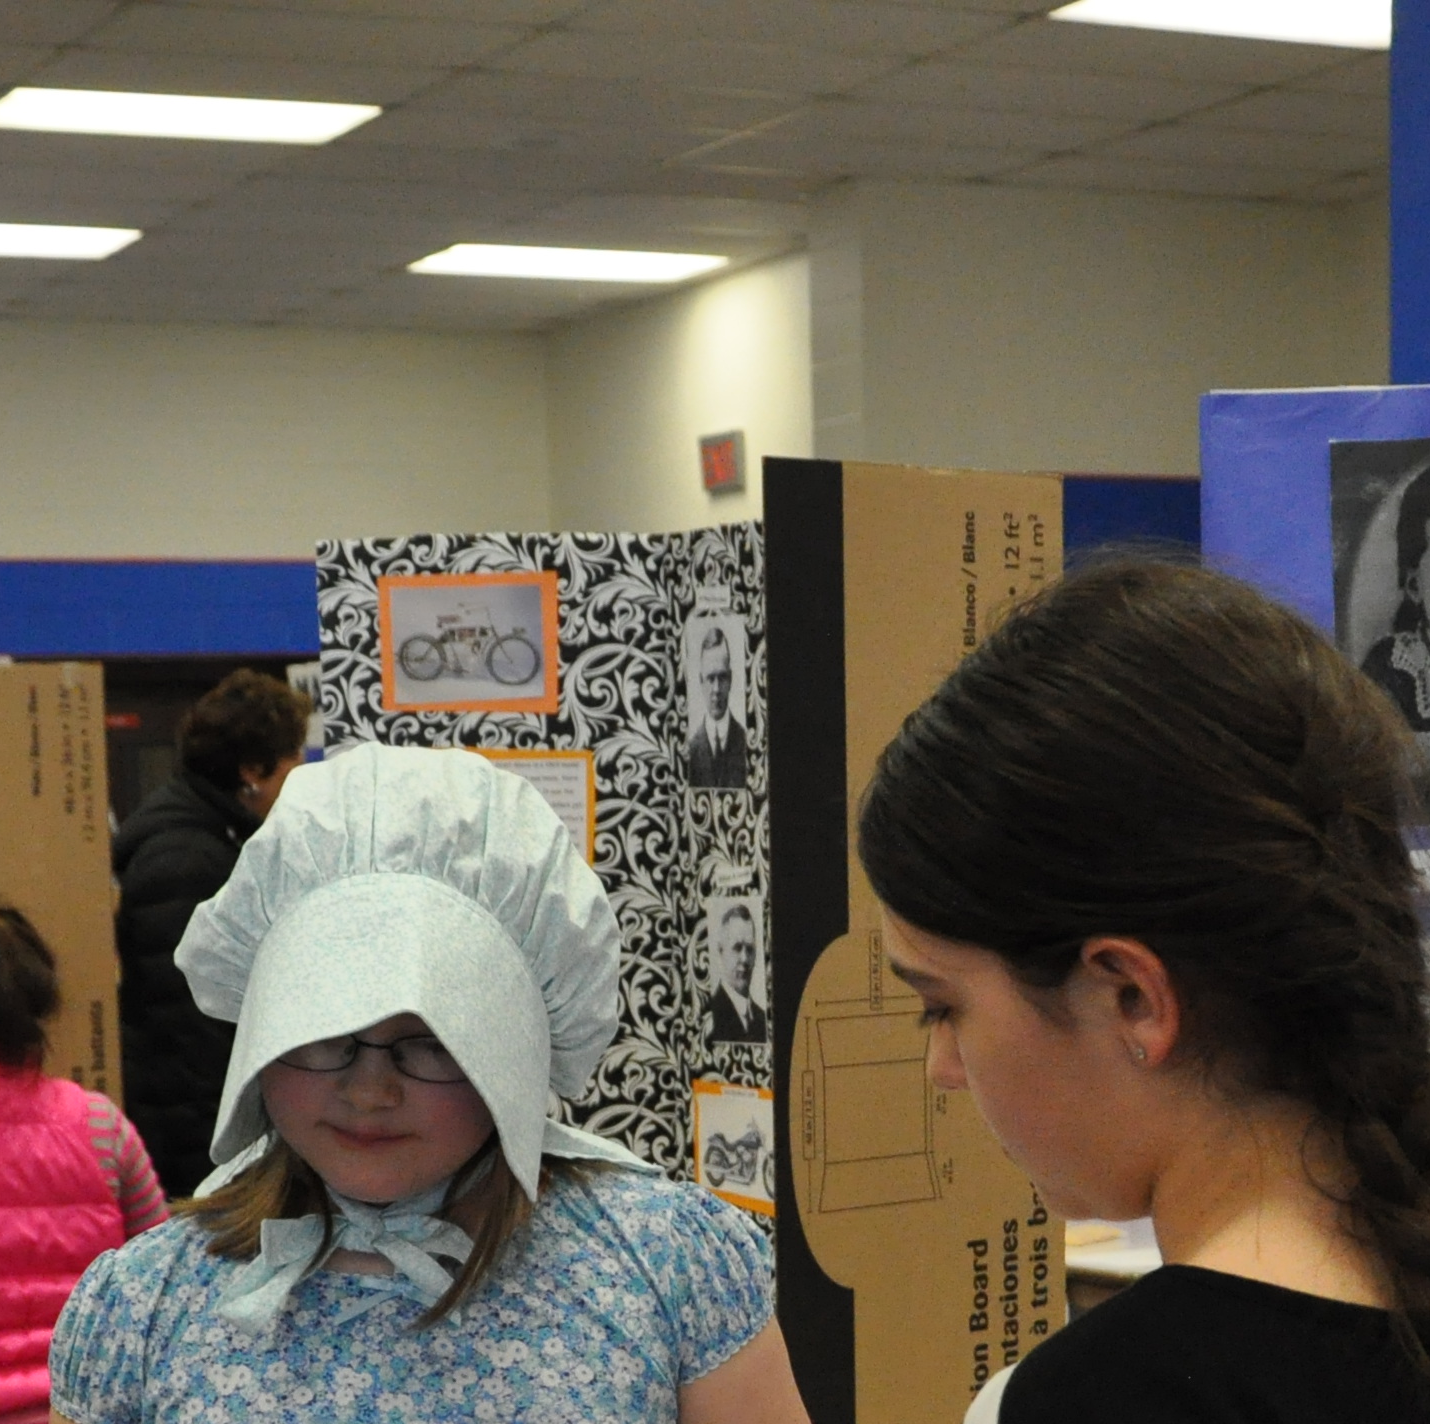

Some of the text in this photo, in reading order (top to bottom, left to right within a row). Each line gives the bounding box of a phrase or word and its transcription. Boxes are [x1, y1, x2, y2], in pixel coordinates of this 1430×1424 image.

[962, 511, 976, 564] Blanc
[1004, 546, 1020, 570] 12
[962, 583, 976, 647] Blanco
[967, 1238, 989, 1333] Board
[999, 1219, 1019, 1367] ntaciones
[1029, 1237, 1048, 1308] trois
[1029, 1319, 1048, 1336] à
